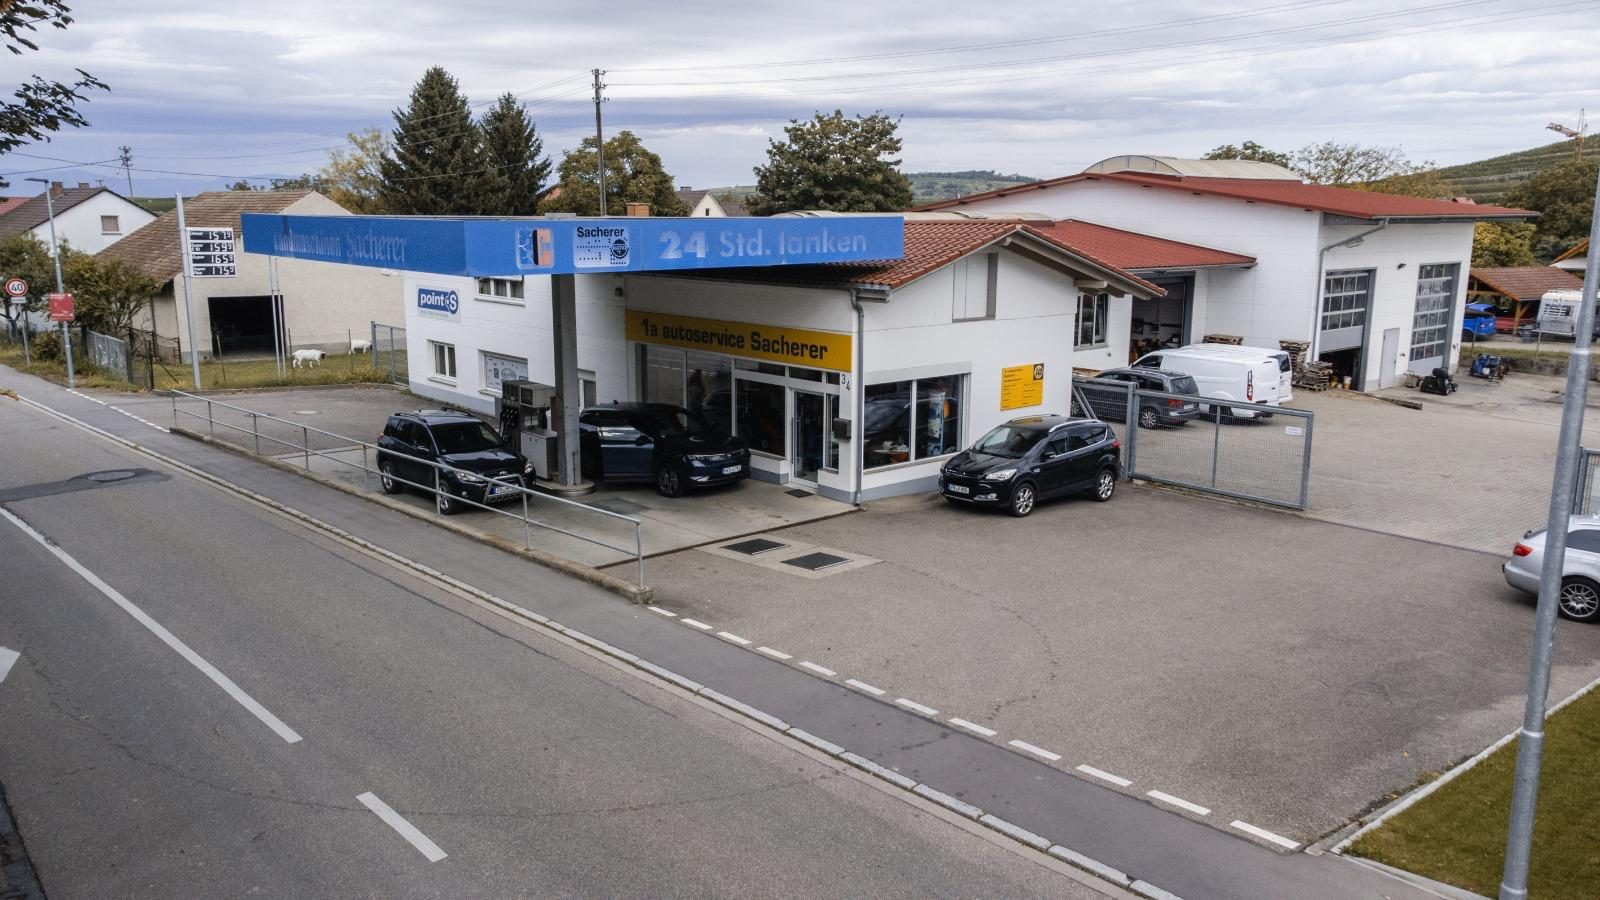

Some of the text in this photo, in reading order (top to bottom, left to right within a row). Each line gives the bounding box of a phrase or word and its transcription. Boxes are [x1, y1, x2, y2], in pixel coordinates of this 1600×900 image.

[346, 226, 407, 262] Sacherer
[577, 227, 624, 238] Sacherer
[659, 230, 709, 259] 24
[719, 228, 771, 257] Std.
[11, 283, 23, 292] 40
[420, 292, 457, 311] point S
[641, 318, 828, 360] 1a autoservice Sacherer
